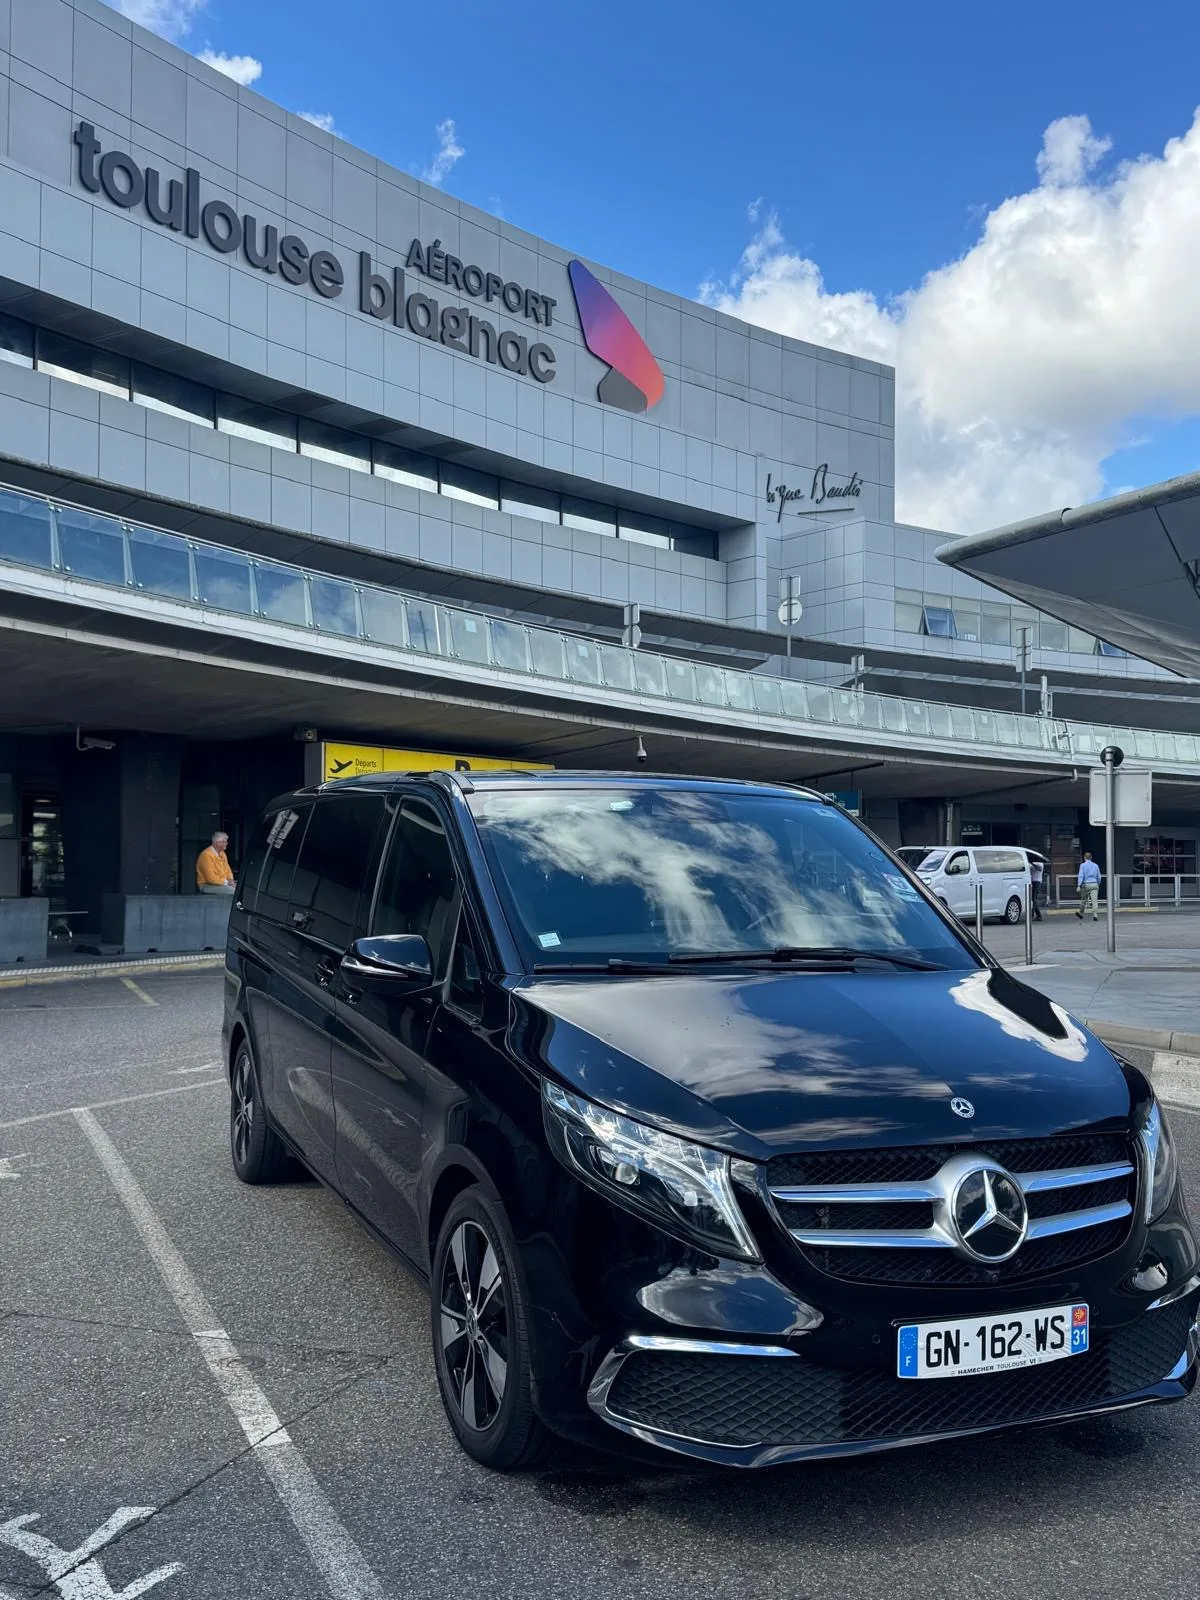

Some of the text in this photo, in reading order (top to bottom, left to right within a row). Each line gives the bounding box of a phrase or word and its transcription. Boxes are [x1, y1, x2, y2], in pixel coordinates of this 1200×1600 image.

[74, 121, 557, 383] toulouse blagnac
[406, 238, 557, 326] AÉROPORT
[905, 1355, 911, 1367] F
[1073, 1328, 1086, 1346] 31
[958, 1365, 994, 1375] HAMECHER
[997, 1360, 1027, 1369] TOULOUSE
